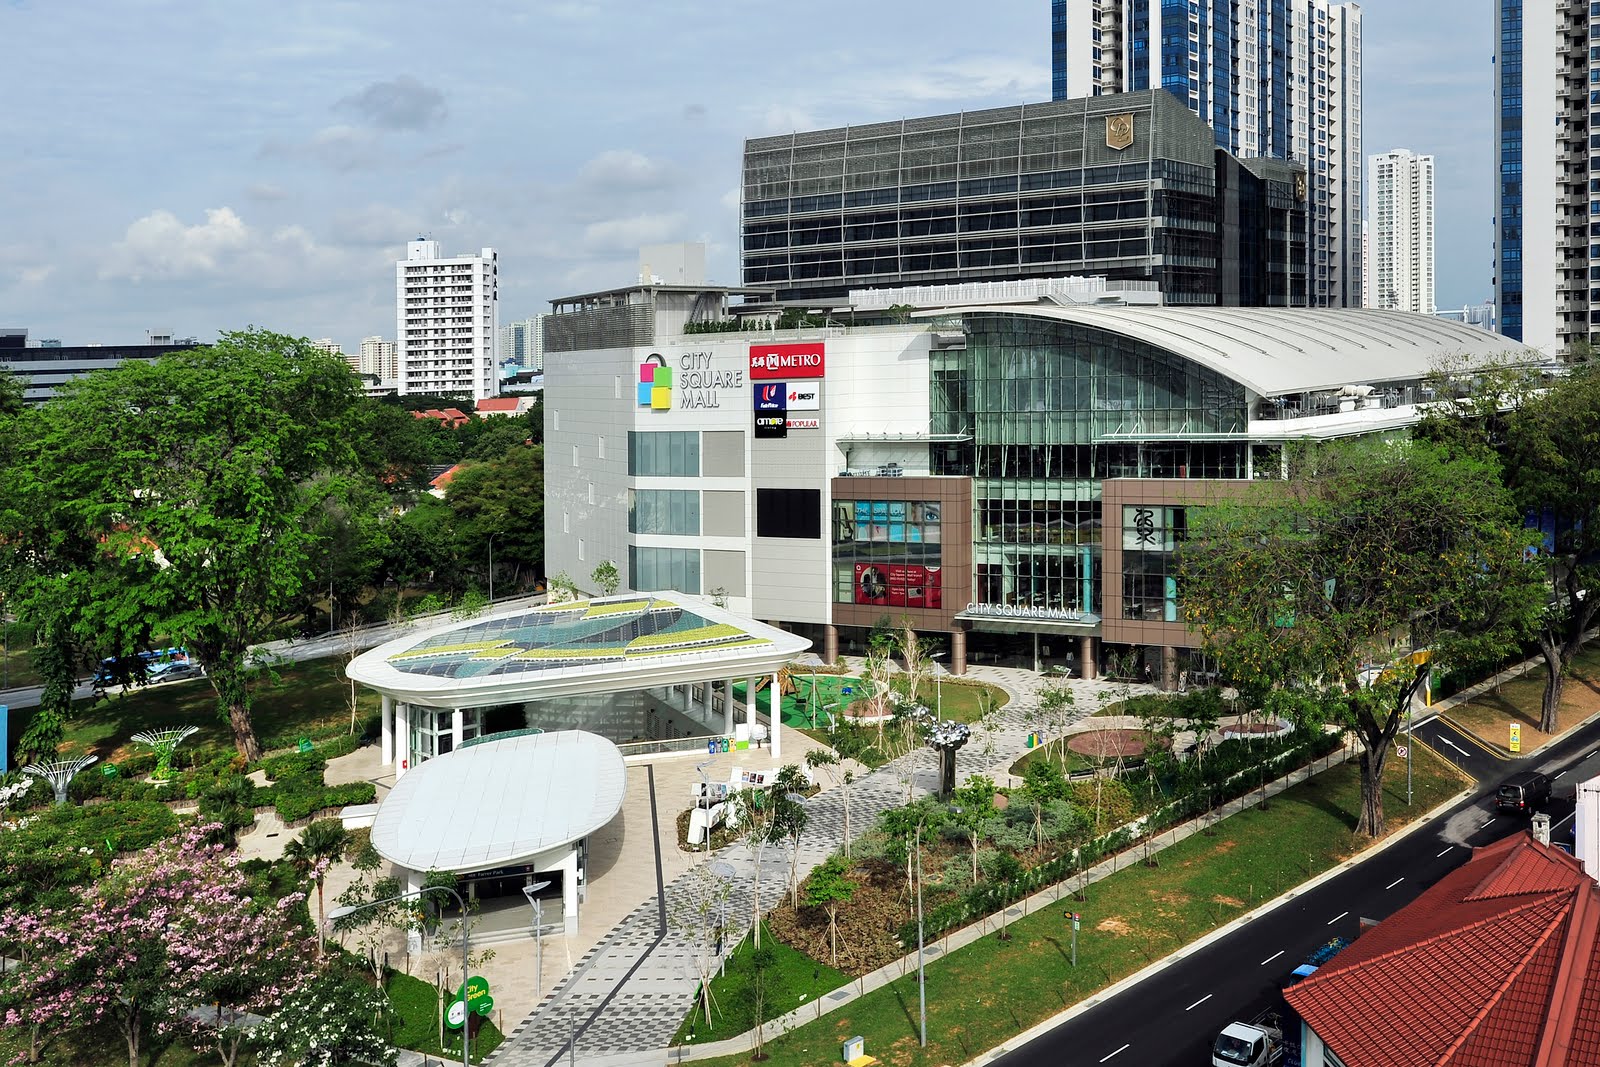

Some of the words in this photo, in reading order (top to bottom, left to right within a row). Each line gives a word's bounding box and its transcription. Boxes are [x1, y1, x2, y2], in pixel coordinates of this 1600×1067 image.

[680, 352, 713, 370] CITY
[780, 353, 821, 367] METRO
[680, 370, 743, 390] SQUARE
[680, 390, 720, 409] MALL
[966, 602, 992, 615] CITY
[995, 603, 1045, 618] SQUARE
[1047, 607, 1080, 620] MALL
